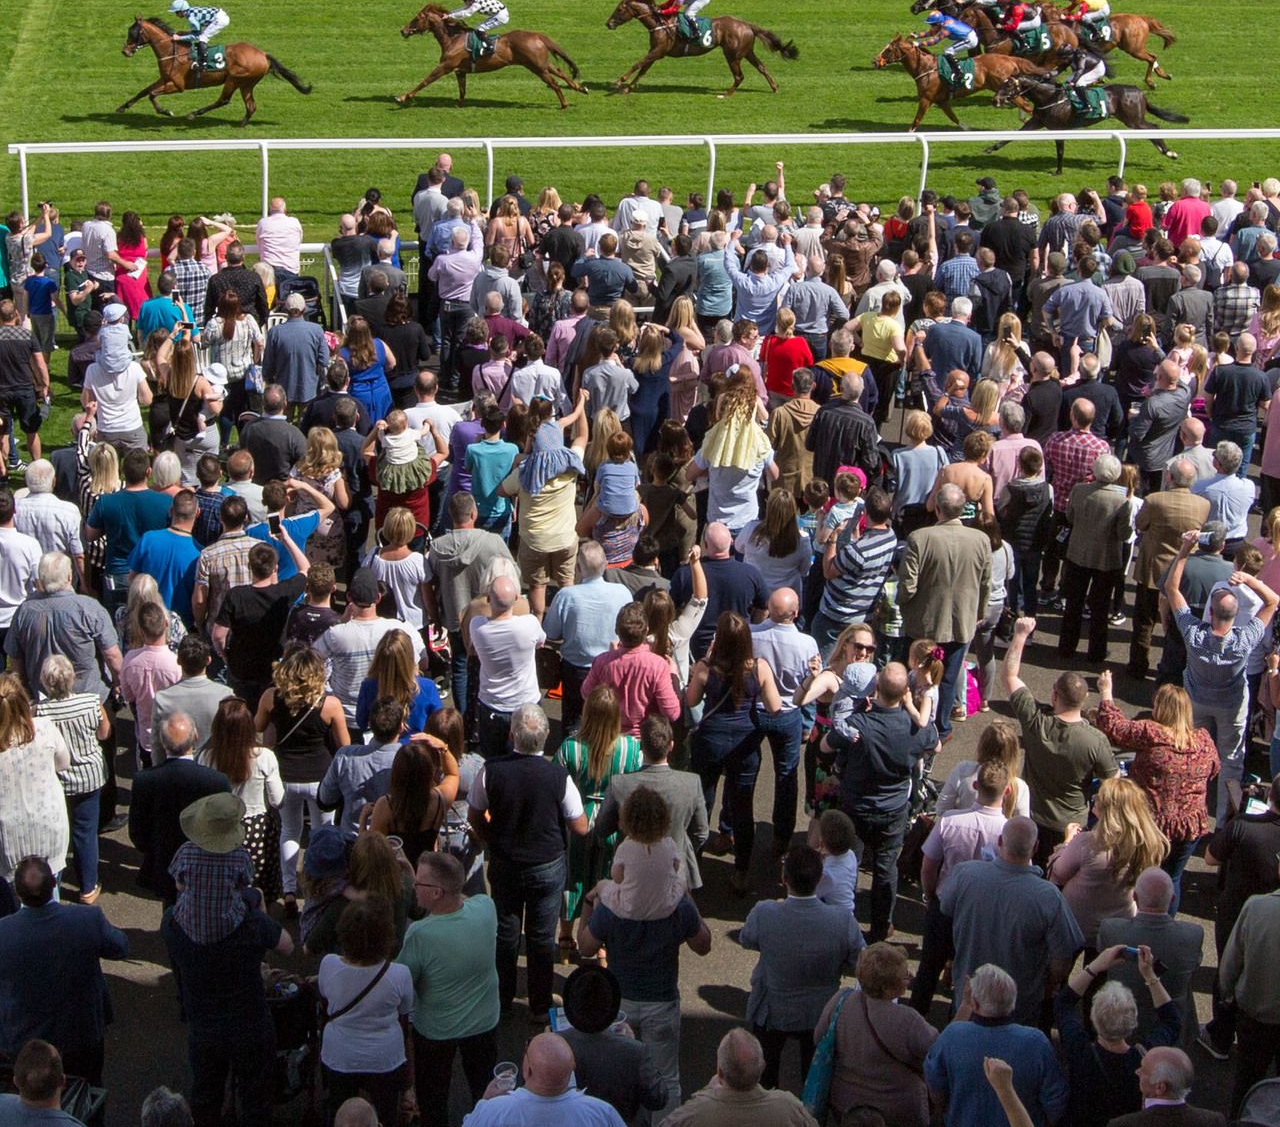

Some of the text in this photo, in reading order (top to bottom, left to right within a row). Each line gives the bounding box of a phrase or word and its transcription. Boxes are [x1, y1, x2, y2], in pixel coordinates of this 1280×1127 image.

[702, 29, 712, 46] 6
[1041, 33, 1050, 49] 5
[1101, 25, 1111, 41] 9
[214, 52, 226, 69] 3
[964, 72, 974, 89] 2
[1099, 100, 1108, 117] 1
